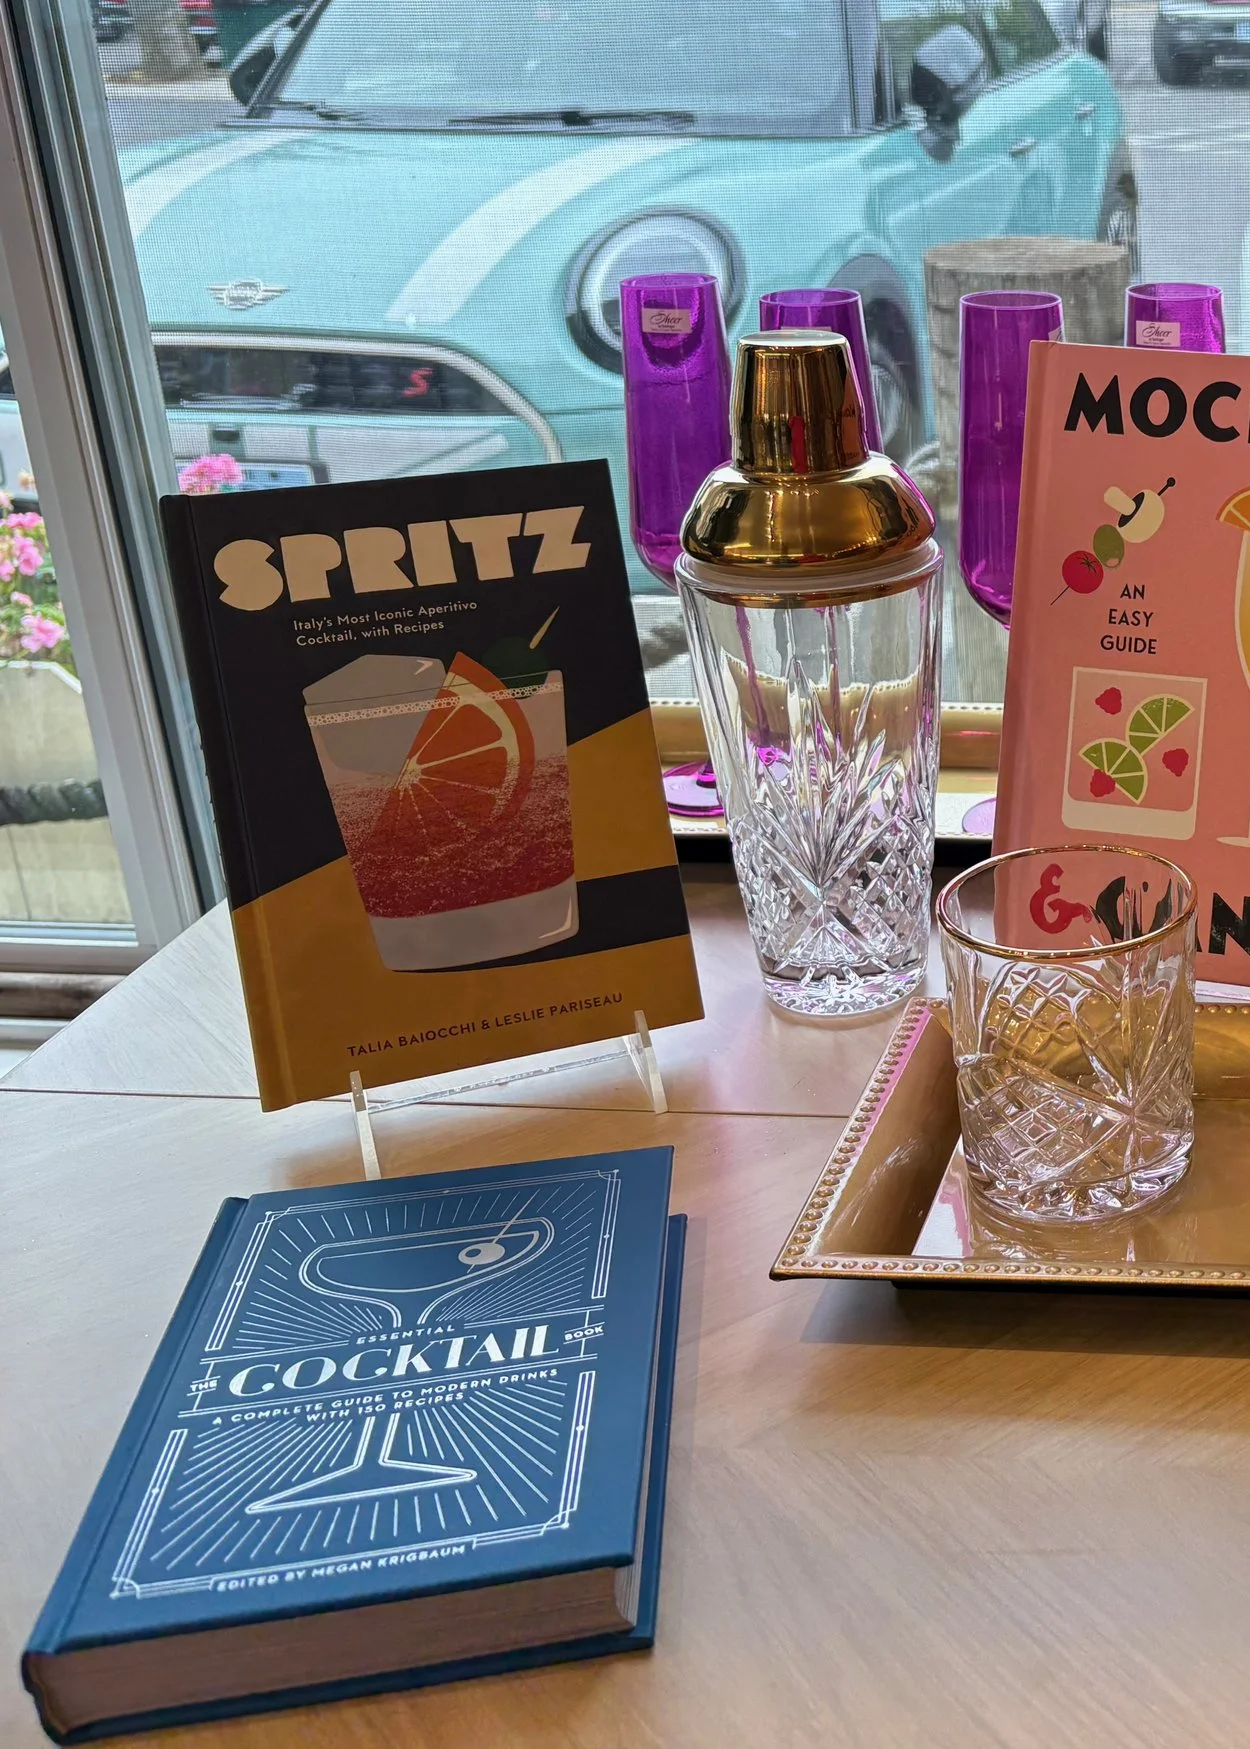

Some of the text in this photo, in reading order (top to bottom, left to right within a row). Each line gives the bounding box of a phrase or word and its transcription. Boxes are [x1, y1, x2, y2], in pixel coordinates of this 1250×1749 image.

[402, 368, 433, 398] S
[213, 505, 592, 611] SPRITZ
[1120, 583, 1145, 600] AN
[293, 600, 478, 632] Italy's Most Iconic Aperitivo
[1108, 608, 1154, 628] EASY
[296, 620, 445, 646] Cocktail, with Recipes
[1100, 634, 1158, 655] GUIDE
[1028, 863, 1092, 934] &
[347, 993, 623, 1057] TALIA BAIOCCHI & LESLIE PARISEAU
[356, 1325, 456, 1344] ESSENTIAL
[189, 1325, 604, 1397] THE COCKTAIL BOOK
[212, 1368, 558, 1425] A COMPLETE GUIDE TO MODERN DRINKS
[306, 1392, 464, 1422] WITH 150 RECIPES
[216, 1545, 466, 1592] EDITED BY MEGAN KRIGBAUM
